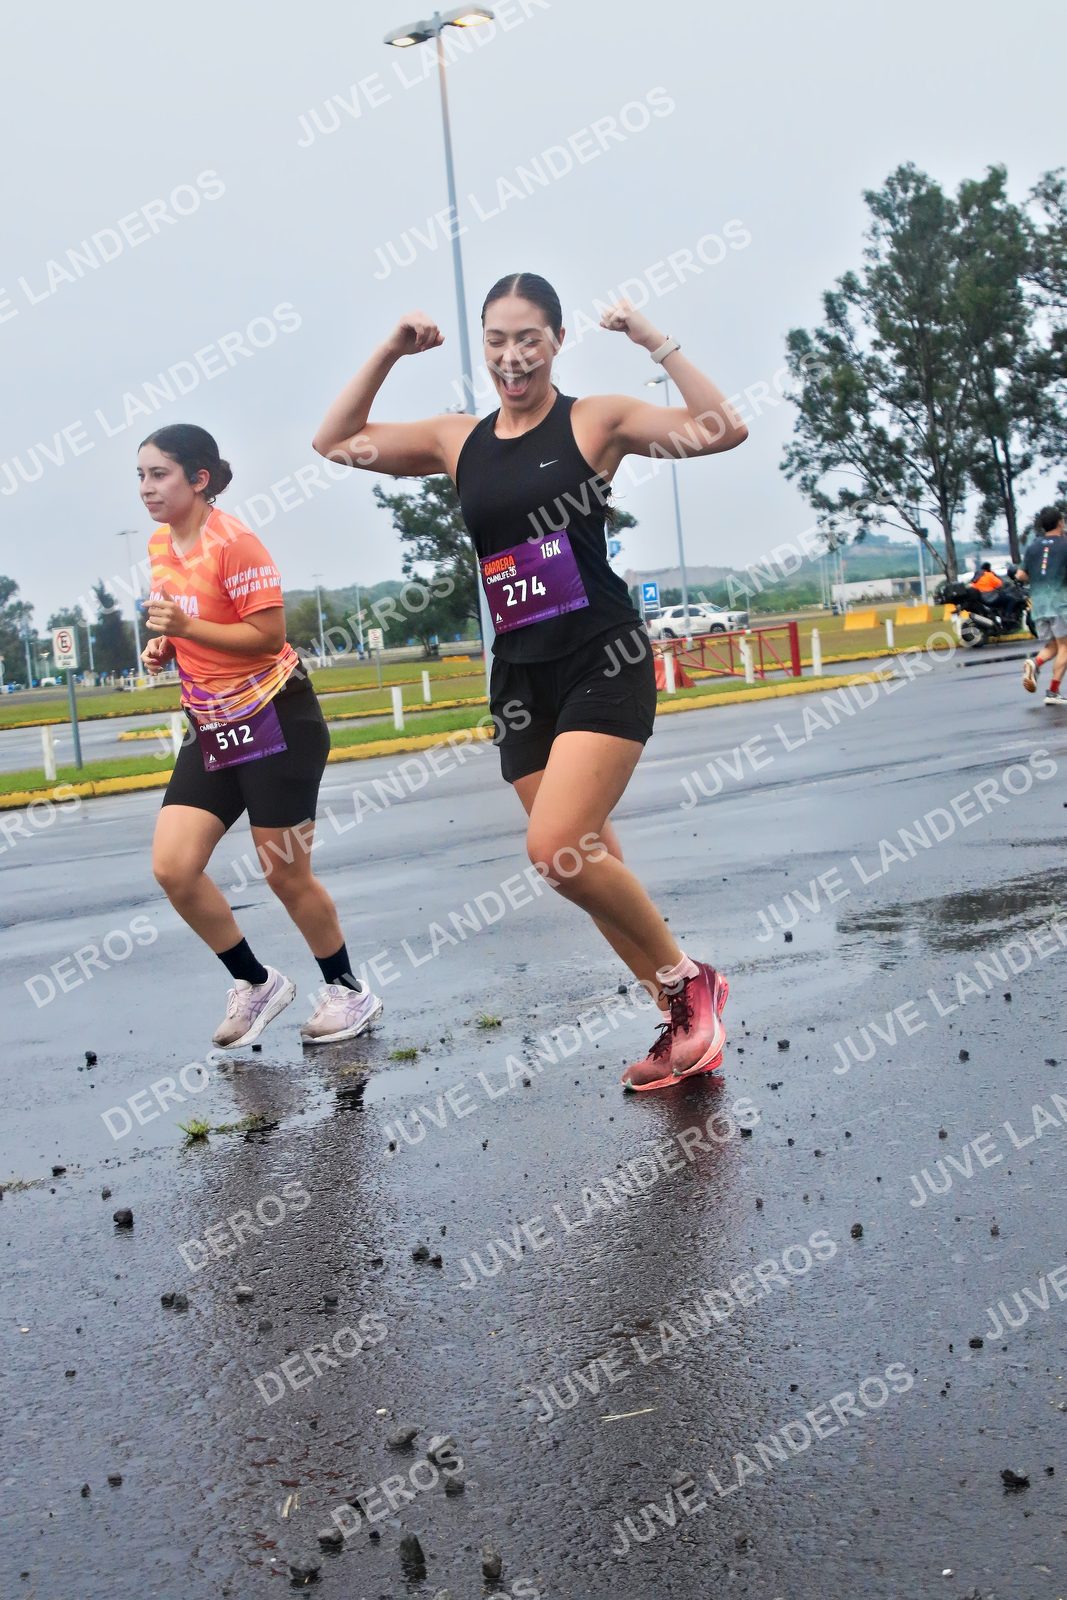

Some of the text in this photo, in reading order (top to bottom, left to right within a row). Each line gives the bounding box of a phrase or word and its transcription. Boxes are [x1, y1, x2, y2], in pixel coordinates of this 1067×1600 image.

[540, 539, 562, 559] 15K
[484, 555, 516, 577] CARRERA
[502, 576, 547, 607] 274
[215, 725, 254, 750] 512
